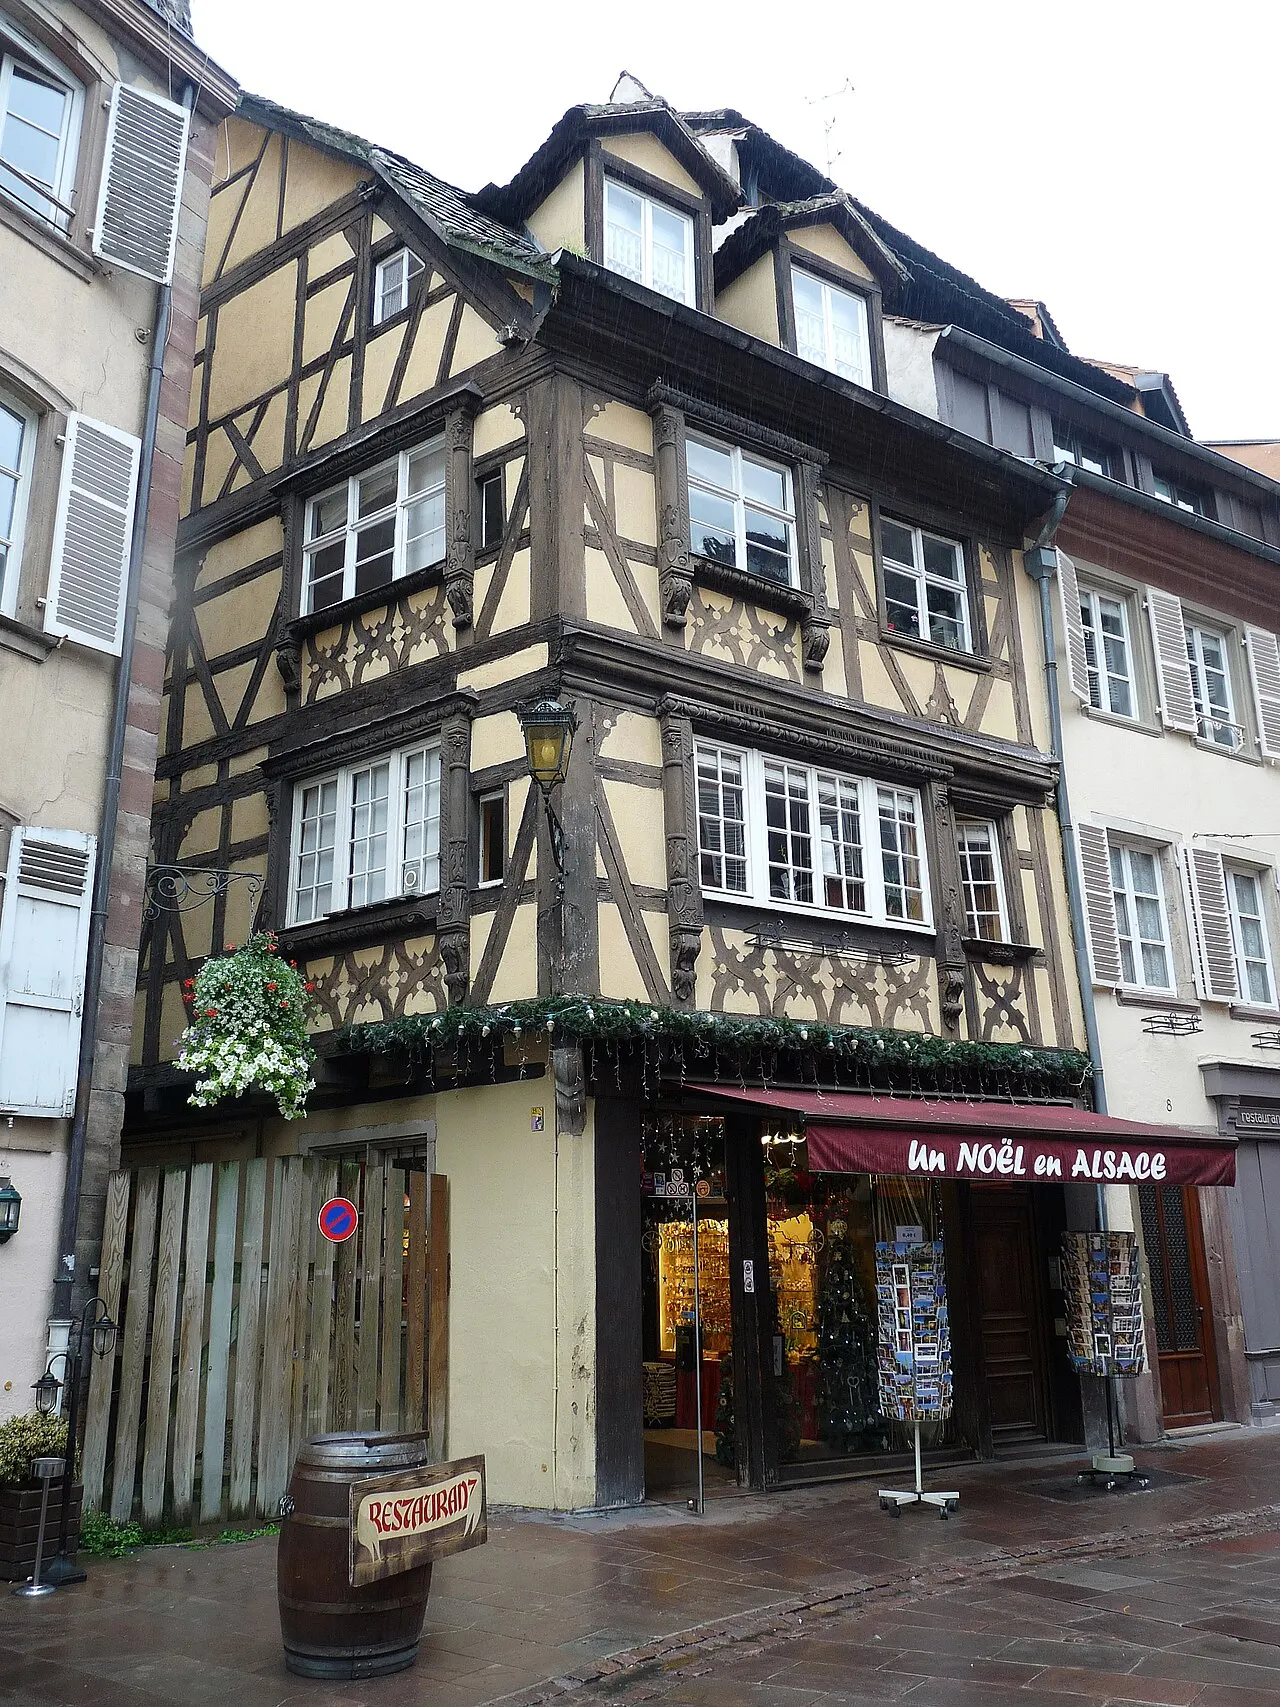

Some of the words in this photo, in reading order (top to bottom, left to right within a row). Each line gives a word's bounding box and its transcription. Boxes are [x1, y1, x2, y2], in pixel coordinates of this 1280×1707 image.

[1166, 1098, 1173, 1112] 8
[908, 1139, 946, 1171] Un
[956, 1138, 1026, 1175] NOËL
[1034, 1154, 1061, 1176] en
[1071, 1149, 1167, 1179] ALSACE
[369, 1479, 478, 1534] RESTAURANT
